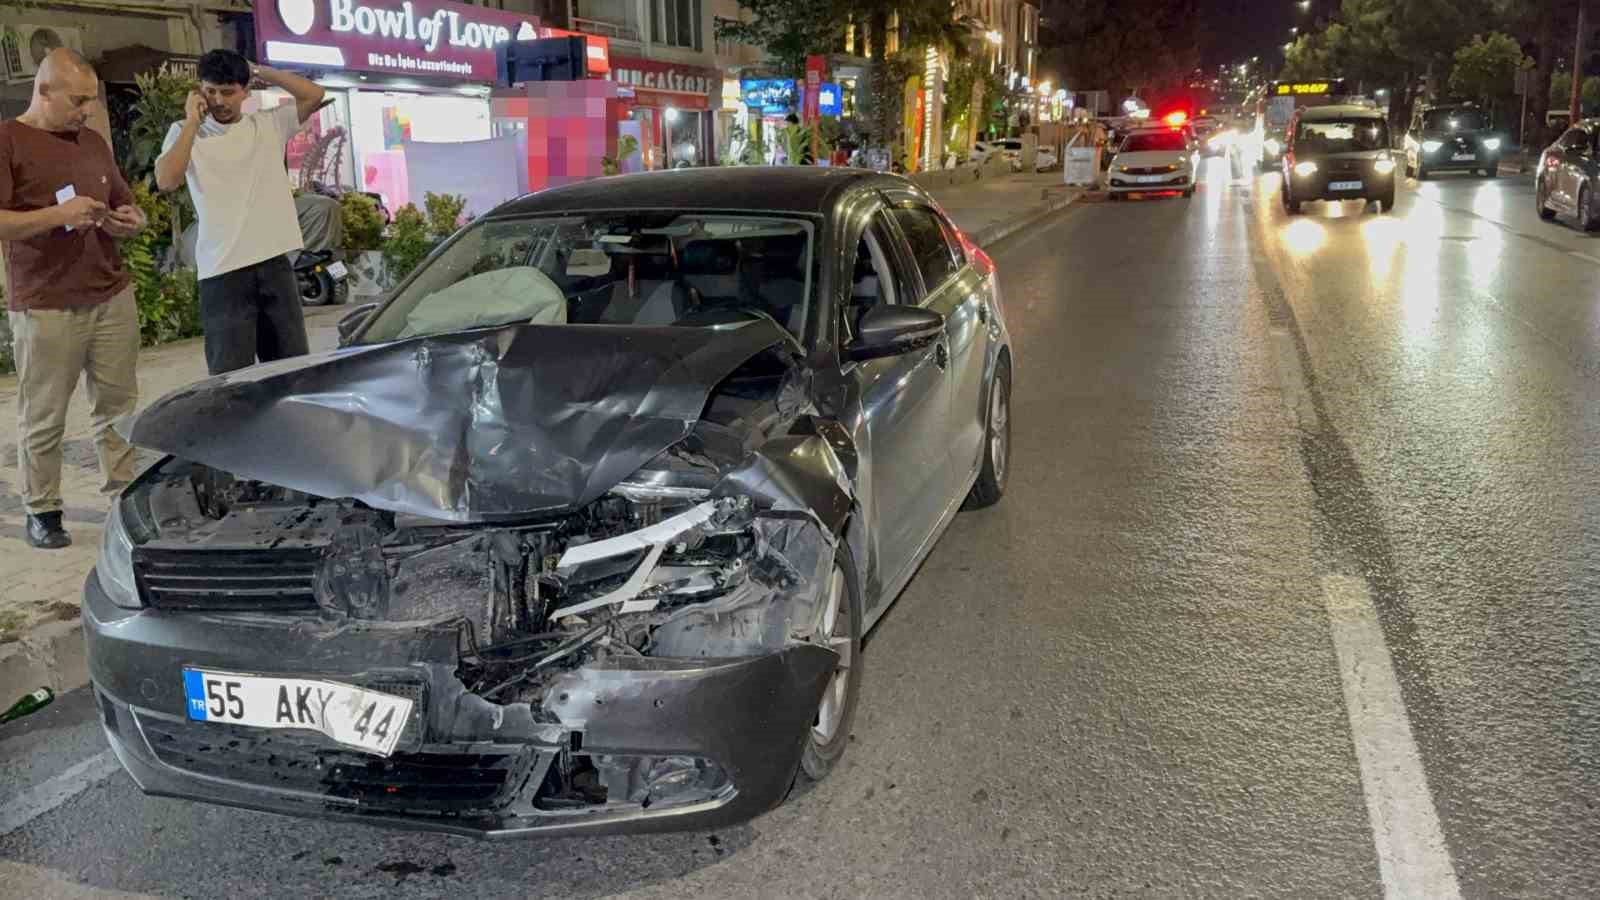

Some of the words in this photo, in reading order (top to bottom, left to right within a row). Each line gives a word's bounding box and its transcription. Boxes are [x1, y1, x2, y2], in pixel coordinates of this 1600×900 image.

[330, 0, 416, 40] Bowl
[418, 9, 446, 52] of
[448, 12, 510, 49] Love
[191, 699, 206, 711] TR
[207, 679, 244, 719] 55
[276, 685, 334, 729] AKY
[353, 701, 396, 744] 44
